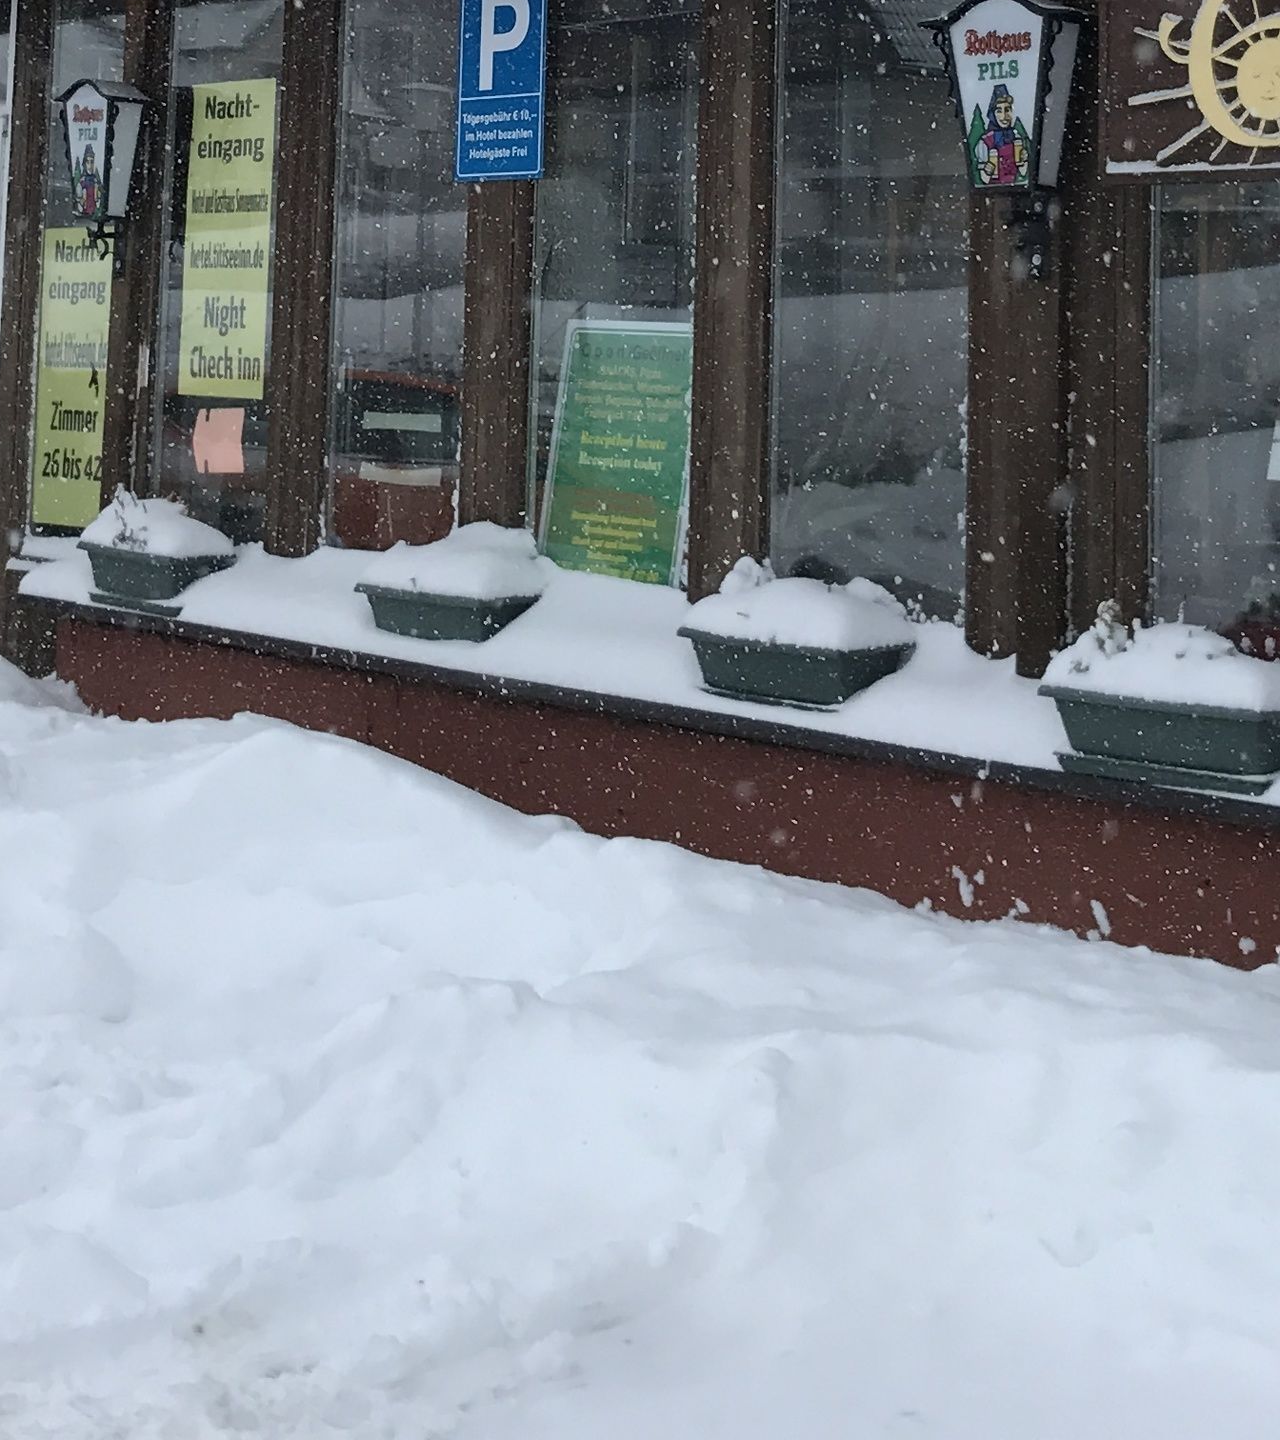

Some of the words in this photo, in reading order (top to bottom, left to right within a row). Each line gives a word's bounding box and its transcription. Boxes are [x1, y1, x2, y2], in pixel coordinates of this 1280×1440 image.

[964, 29, 1032, 58] Rothaus
[977, 60, 1019, 81] PILS
[205, 93, 260, 120] Nacht-
[513, 110, 519, 121] €
[197, 133, 265, 164] eingang
[465, 131, 475, 141] im
[476, 129, 497, 141] Hotel
[498, 128, 533, 140] bezahlen
[512, 146, 528, 157] Frei
[49, 275, 106, 305] eingang
[204, 296, 246, 336] Night
[190, 345, 233, 380] Check
[237, 348, 261, 381] inn
[50, 401, 99, 432] Zimmer
[42, 448, 60, 478] 26
[62, 448, 82, 480] bis
[84, 455, 102, 481] 42
